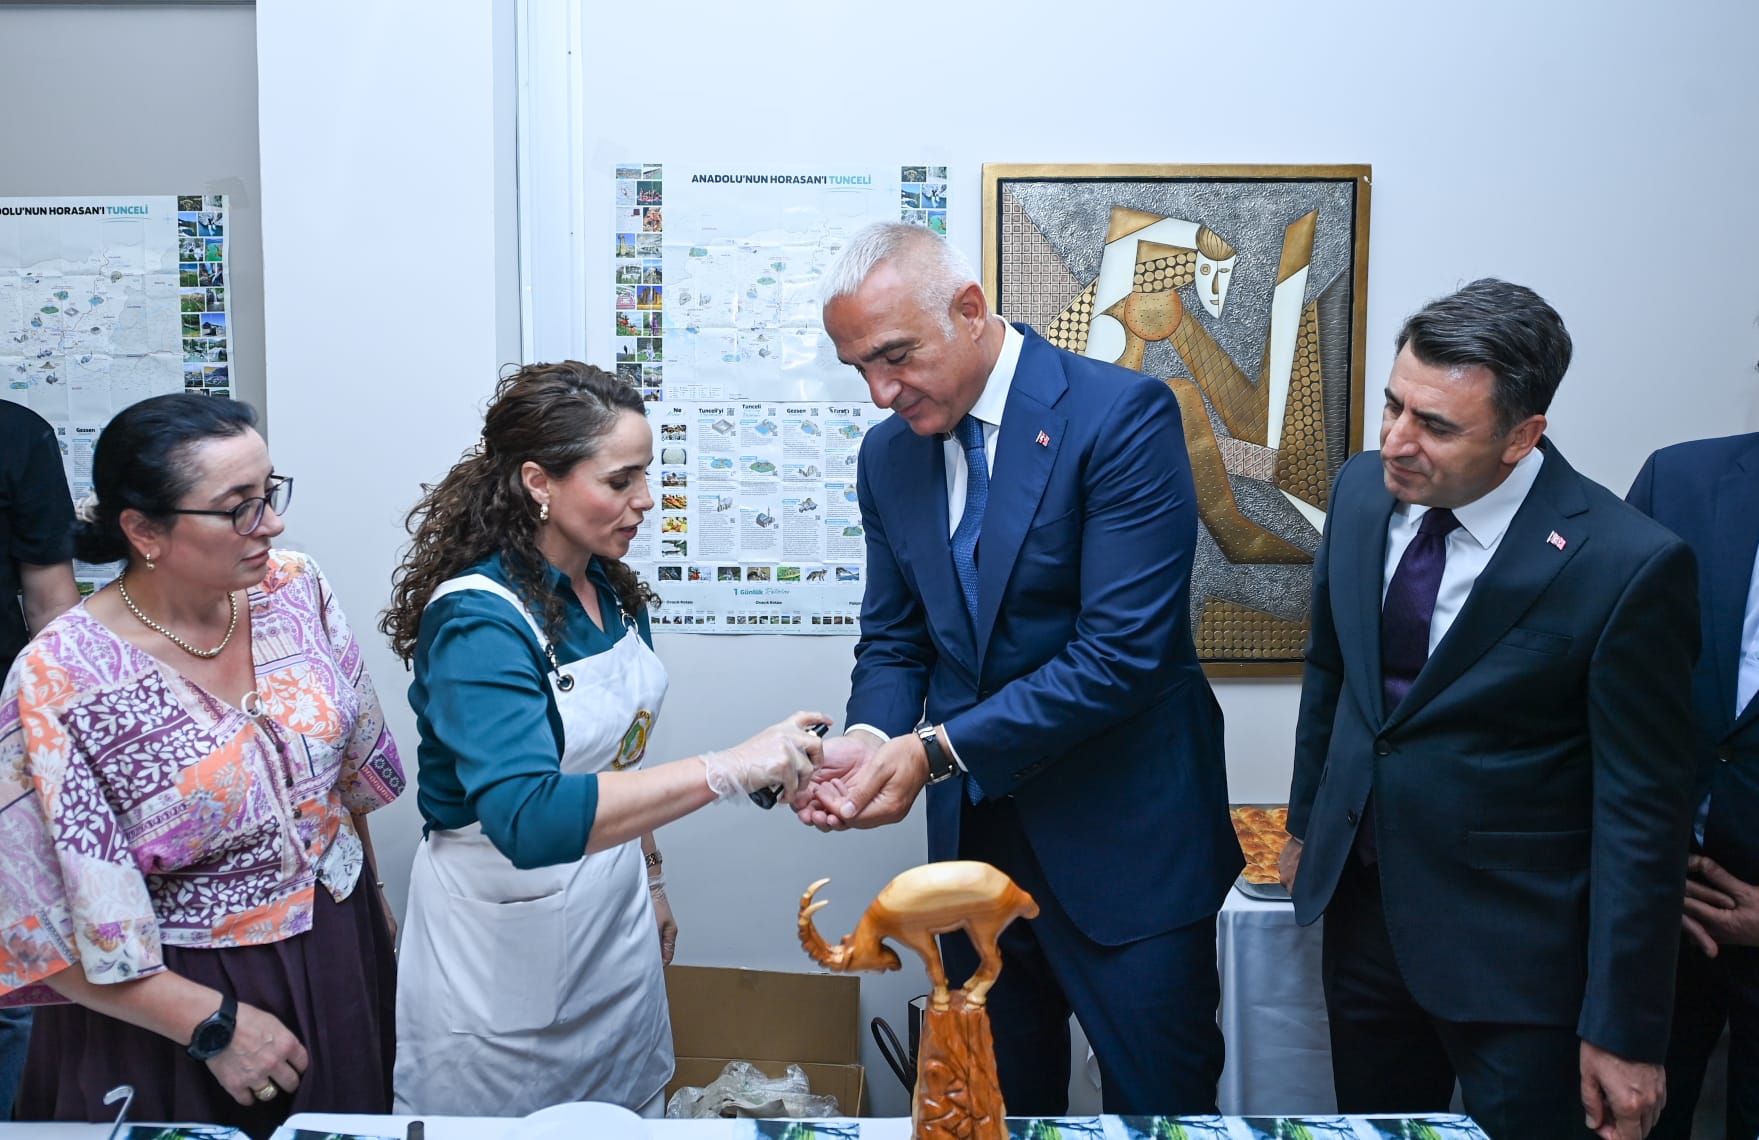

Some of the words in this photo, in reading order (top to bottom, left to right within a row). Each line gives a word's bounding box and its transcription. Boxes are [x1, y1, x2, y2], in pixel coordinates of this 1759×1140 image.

[691, 174, 768, 184] ANADOLU'NUN
[770, 175, 827, 185] HORASAN'I
[829, 174, 872, 185] TUNCELİ
[0, 206, 47, 216] OLU'NUN
[49, 206, 105, 216] HORASAN'I
[106, 204, 149, 215] TUNCELİ
